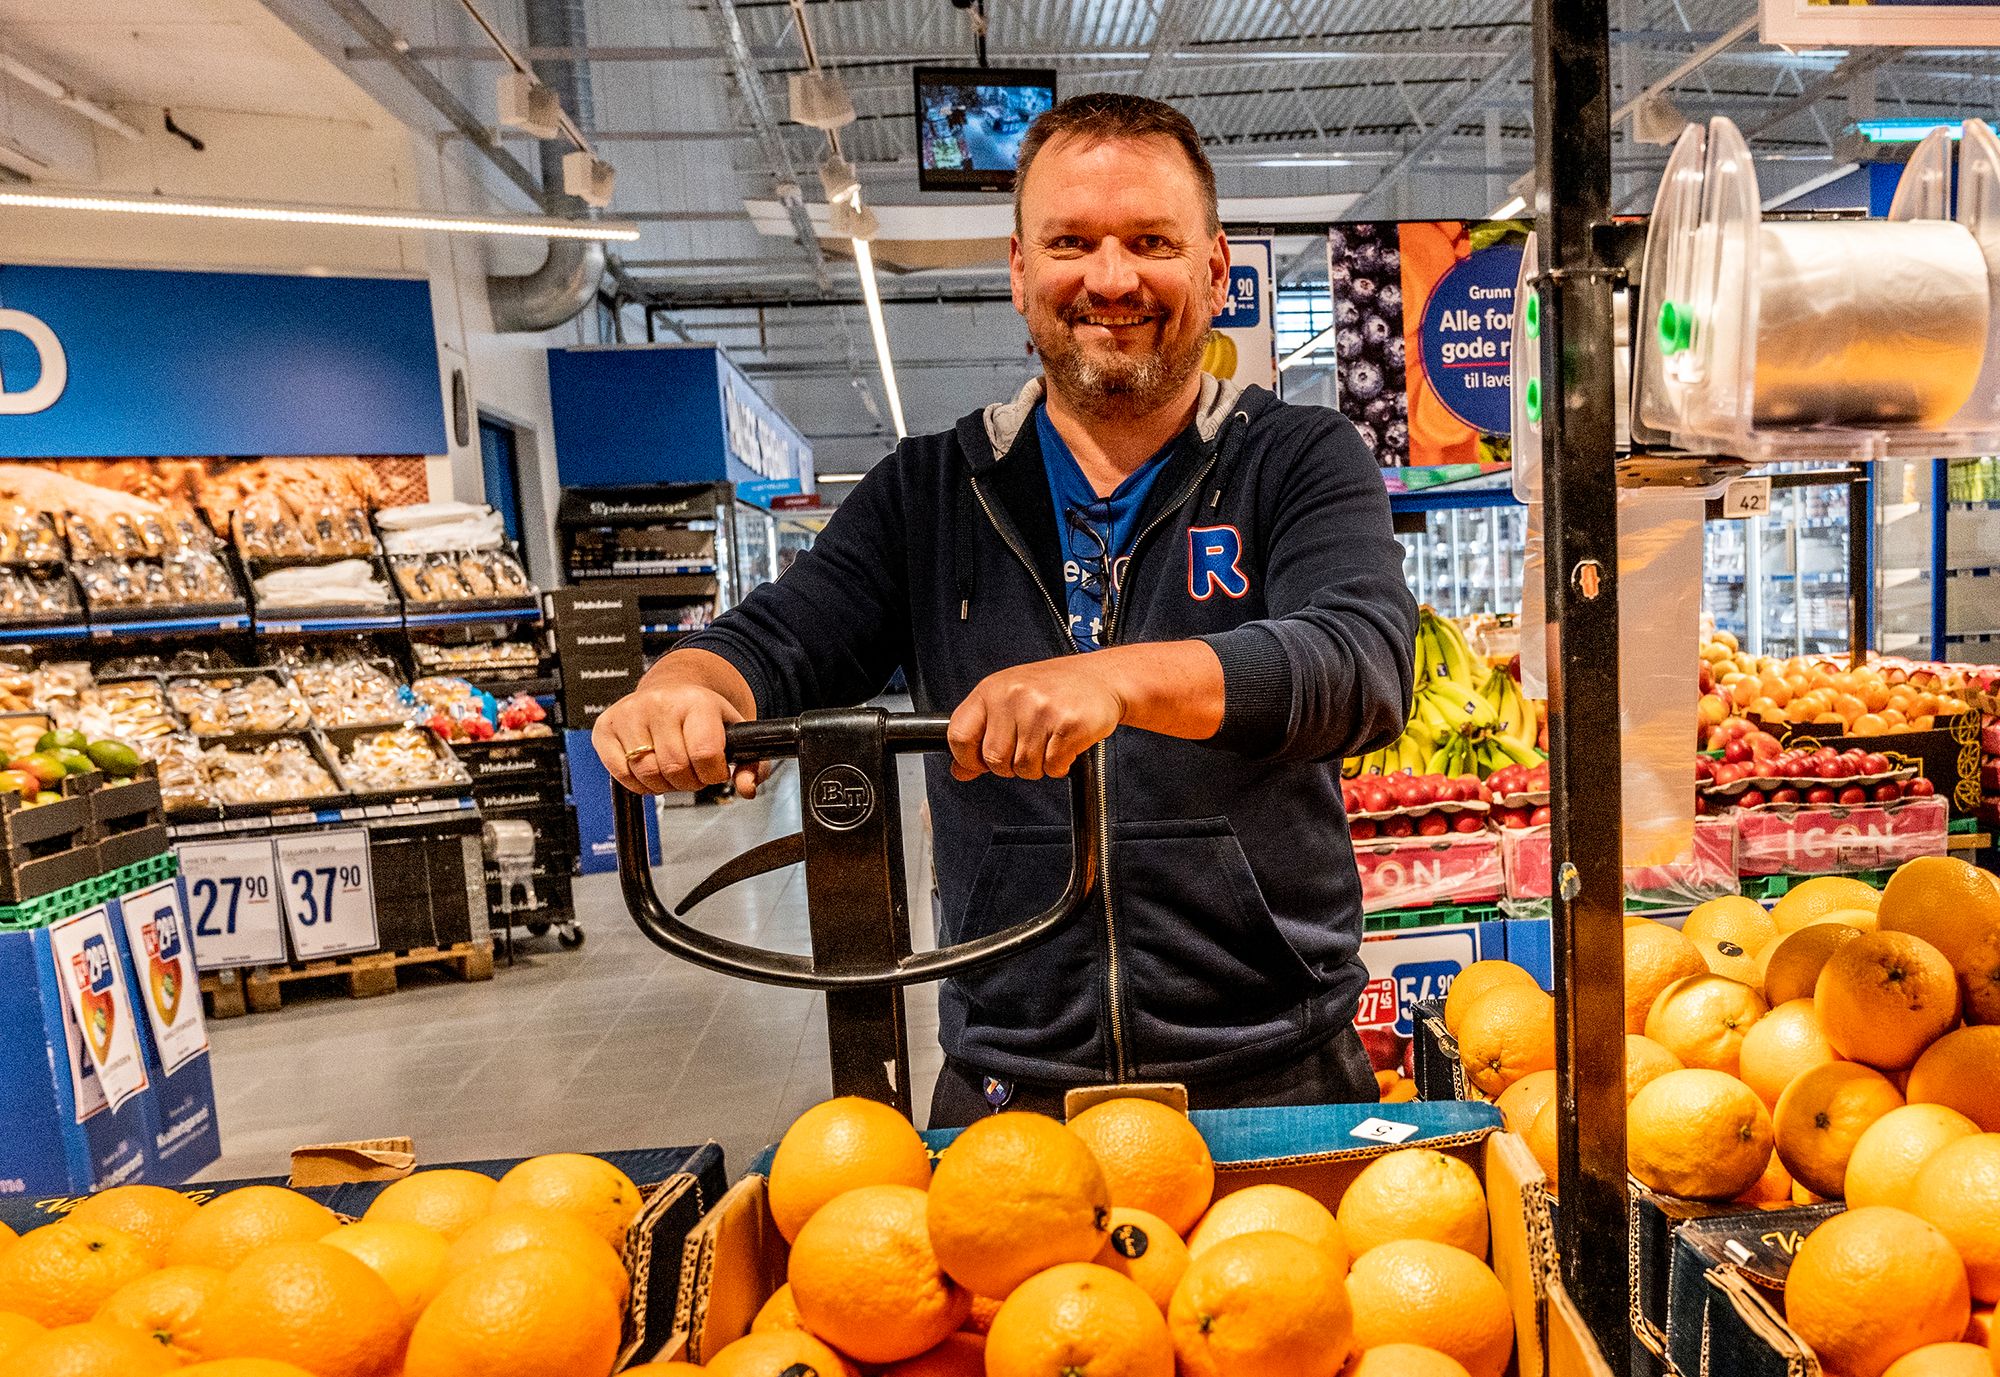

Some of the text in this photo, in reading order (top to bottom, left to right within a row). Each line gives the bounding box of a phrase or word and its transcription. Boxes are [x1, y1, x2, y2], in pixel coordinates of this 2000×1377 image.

[1237, 278, 1254, 297] 90
[1469, 285, 1511, 300] Grunn
[1439, 309, 1481, 332] Alle
[0, 308, 67, 415] D
[1441, 336, 1496, 364] gode
[1464, 372, 1479, 388] til
[1187, 524, 1249, 601] R
[821, 780, 865, 807] BT
[1786, 822, 1894, 861] ICON
[1358, 858, 1442, 892] ON
[193, 877, 242, 936] 27
[245, 876, 268, 898] 90
[291, 866, 361, 926] 37 90
[1358, 992, 1379, 1023] 27
